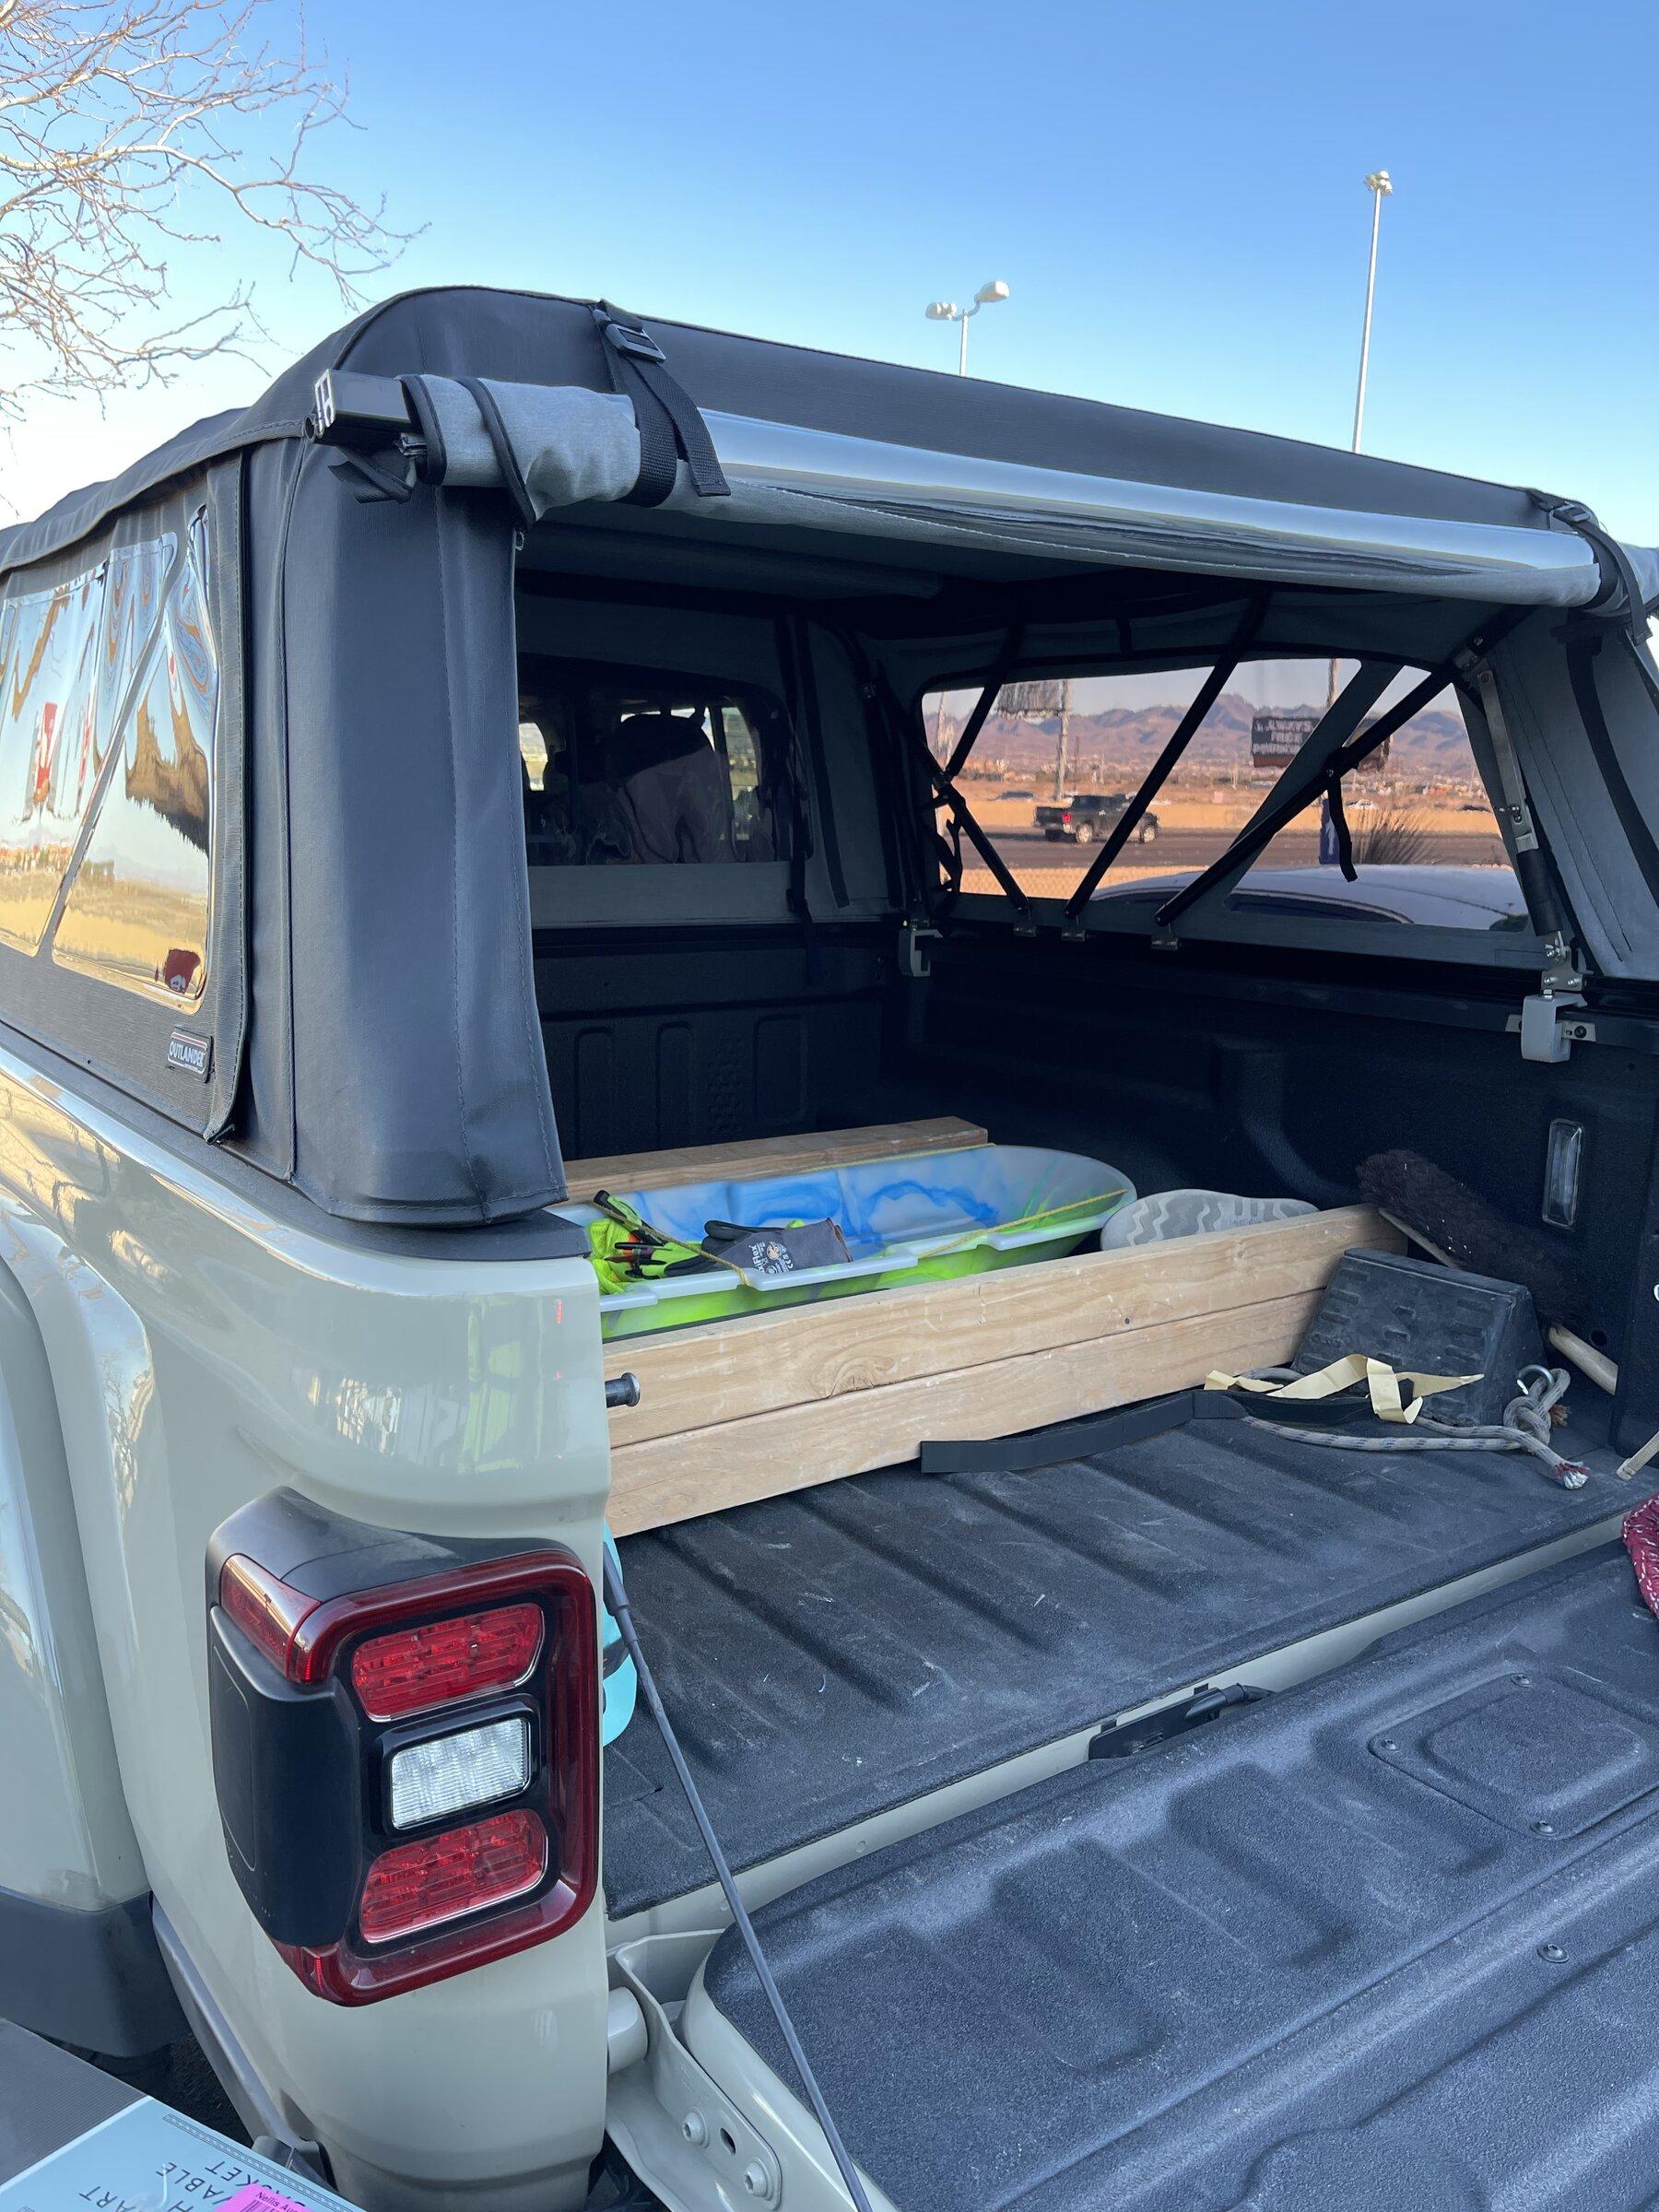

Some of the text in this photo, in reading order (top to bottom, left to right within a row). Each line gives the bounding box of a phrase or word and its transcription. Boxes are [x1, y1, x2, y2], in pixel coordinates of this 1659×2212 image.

[169, 1041, 206, 1068] OUTLANDER
[751, 1244, 766, 1273] xiFlex
[78, 2185, 142, 2212] ART
[256, 2192, 280, 2207] Nellis
